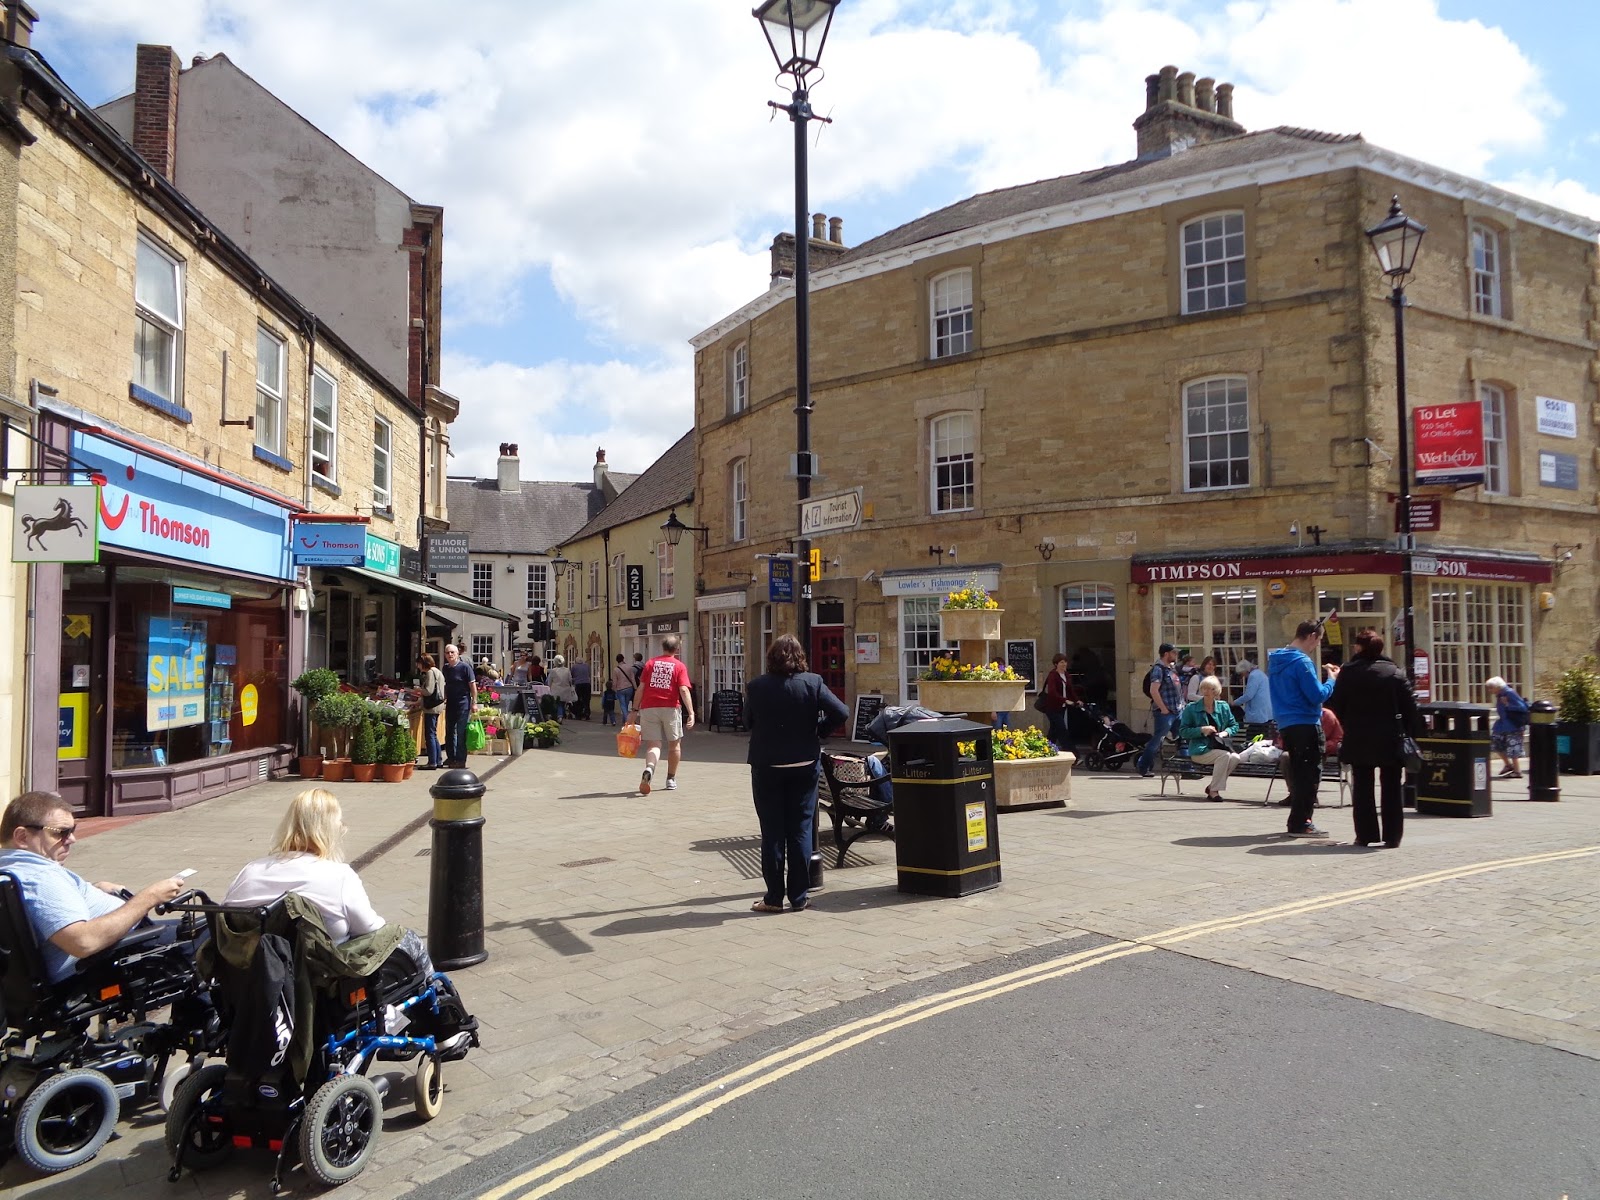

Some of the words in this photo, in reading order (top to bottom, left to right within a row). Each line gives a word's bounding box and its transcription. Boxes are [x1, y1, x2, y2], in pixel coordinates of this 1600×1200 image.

[1418, 408, 1433, 420] To
[1435, 407, 1457, 419] Let
[1452, 429, 1473, 437] Space
[1418, 449, 1477, 466] Wetherby
[830, 501, 847, 511] Tourist
[139, 501, 210, 549] Thomson
[823, 512, 852, 525] Information
[322, 541, 359, 549] Thomson
[372, 542, 386, 563] SONS
[1147, 562, 1241, 580] TIMPSON
[630, 568, 640, 608] AZUZU
[802, 584, 812, 593] 18
[931, 578, 967, 589] Fishmonge
[149, 654, 204, 693] SALE
[905, 768, 928, 778] Litter
[1028, 784, 1053, 792] BLOOM
